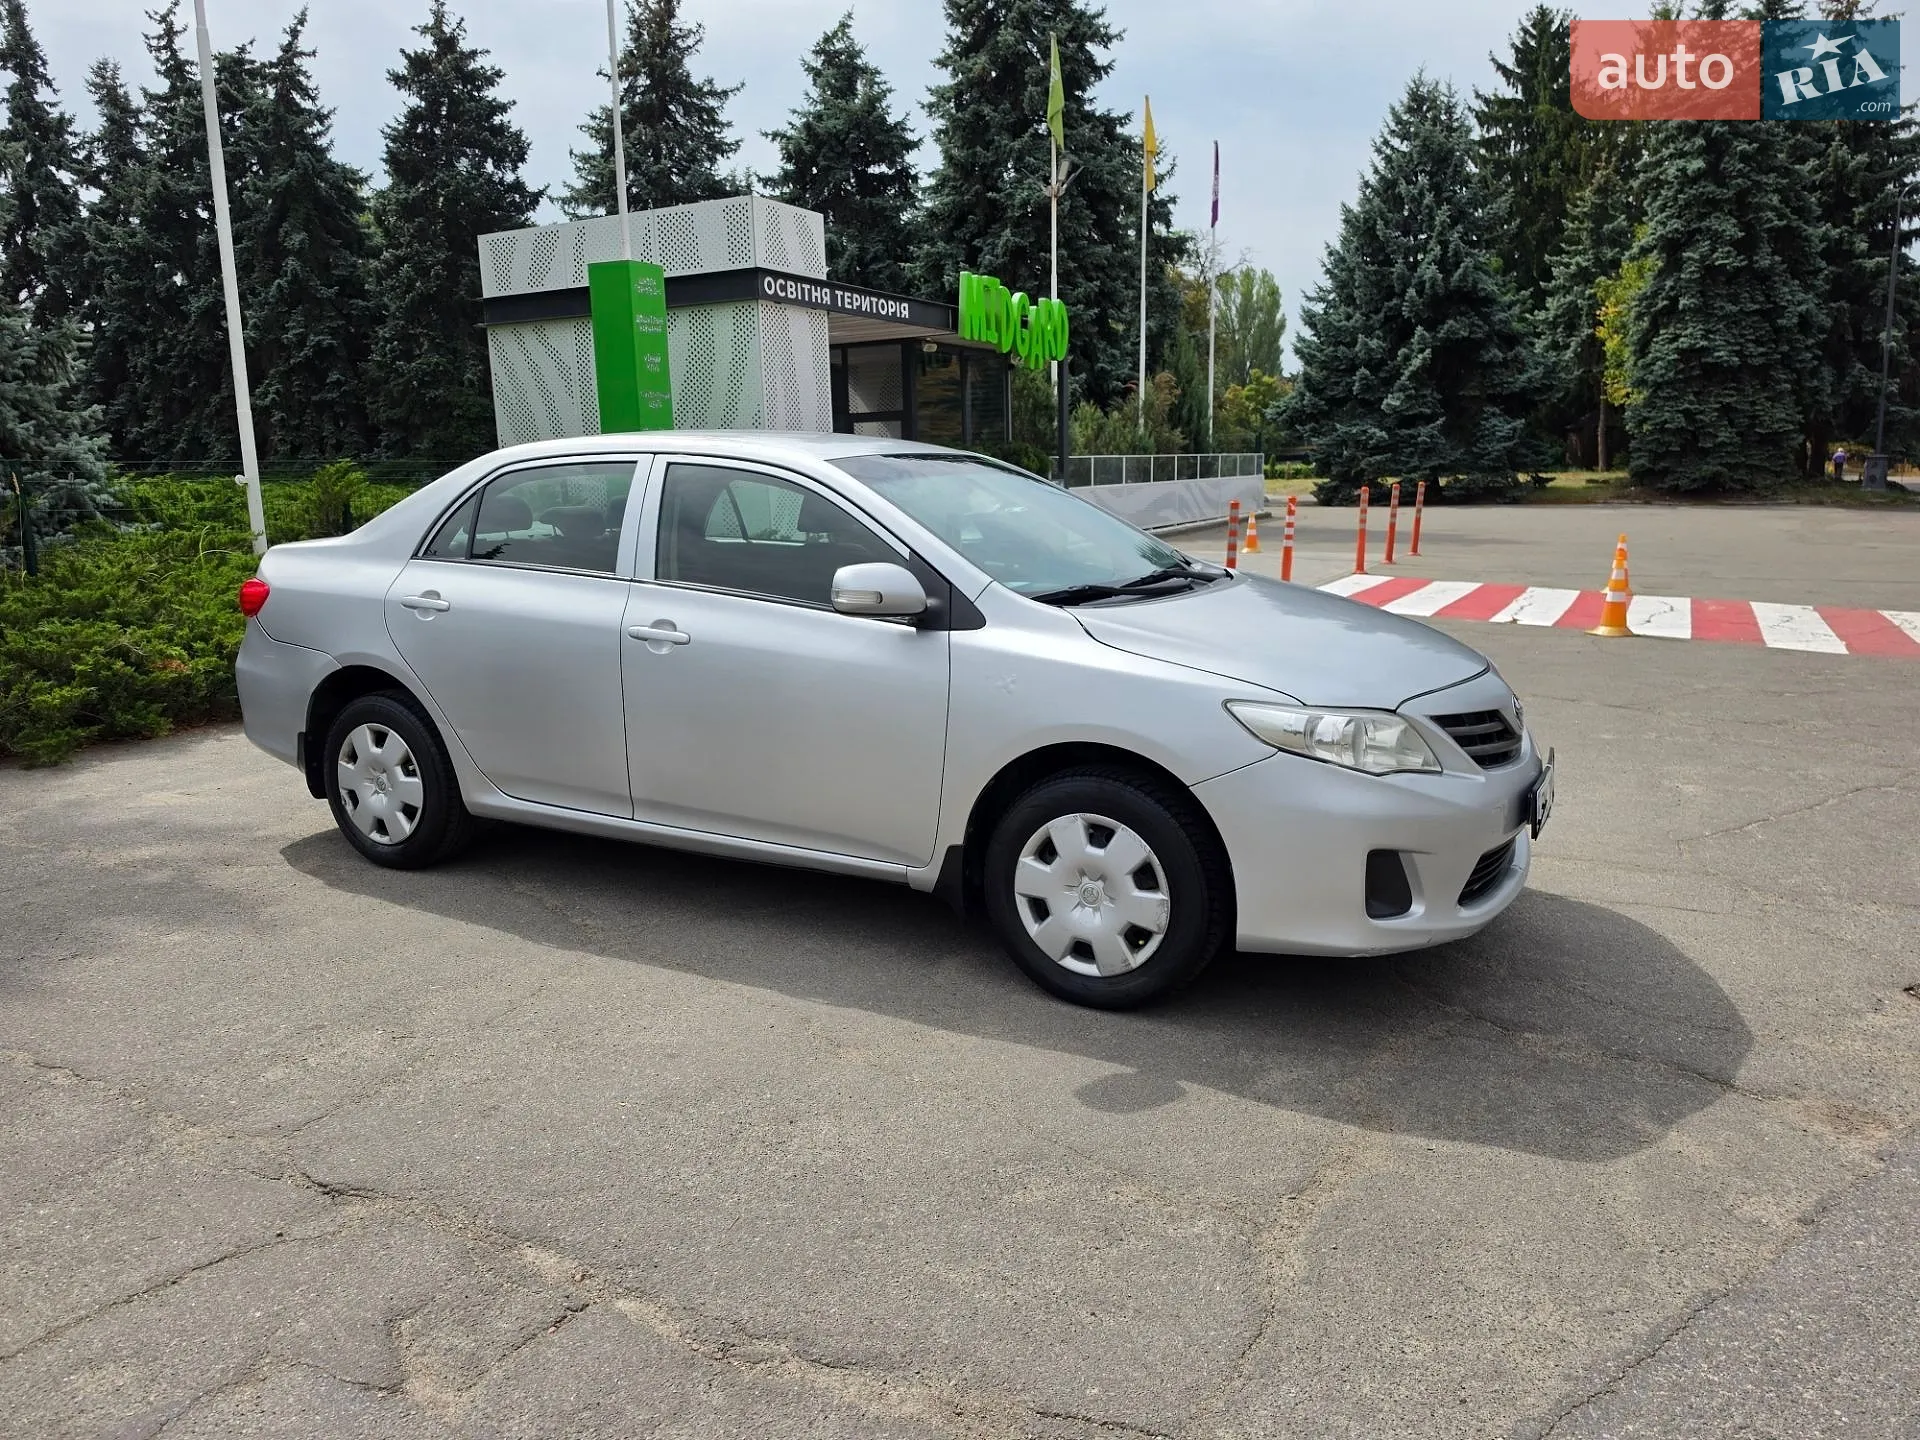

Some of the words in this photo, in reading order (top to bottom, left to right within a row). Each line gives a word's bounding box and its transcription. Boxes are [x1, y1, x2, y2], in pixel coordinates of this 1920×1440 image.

[763, 276, 831, 305] ОСВІТНЯ
[835, 290, 909, 319] ТЕРИТОРІЯ
[958, 271, 1069, 370] MIDGARD
